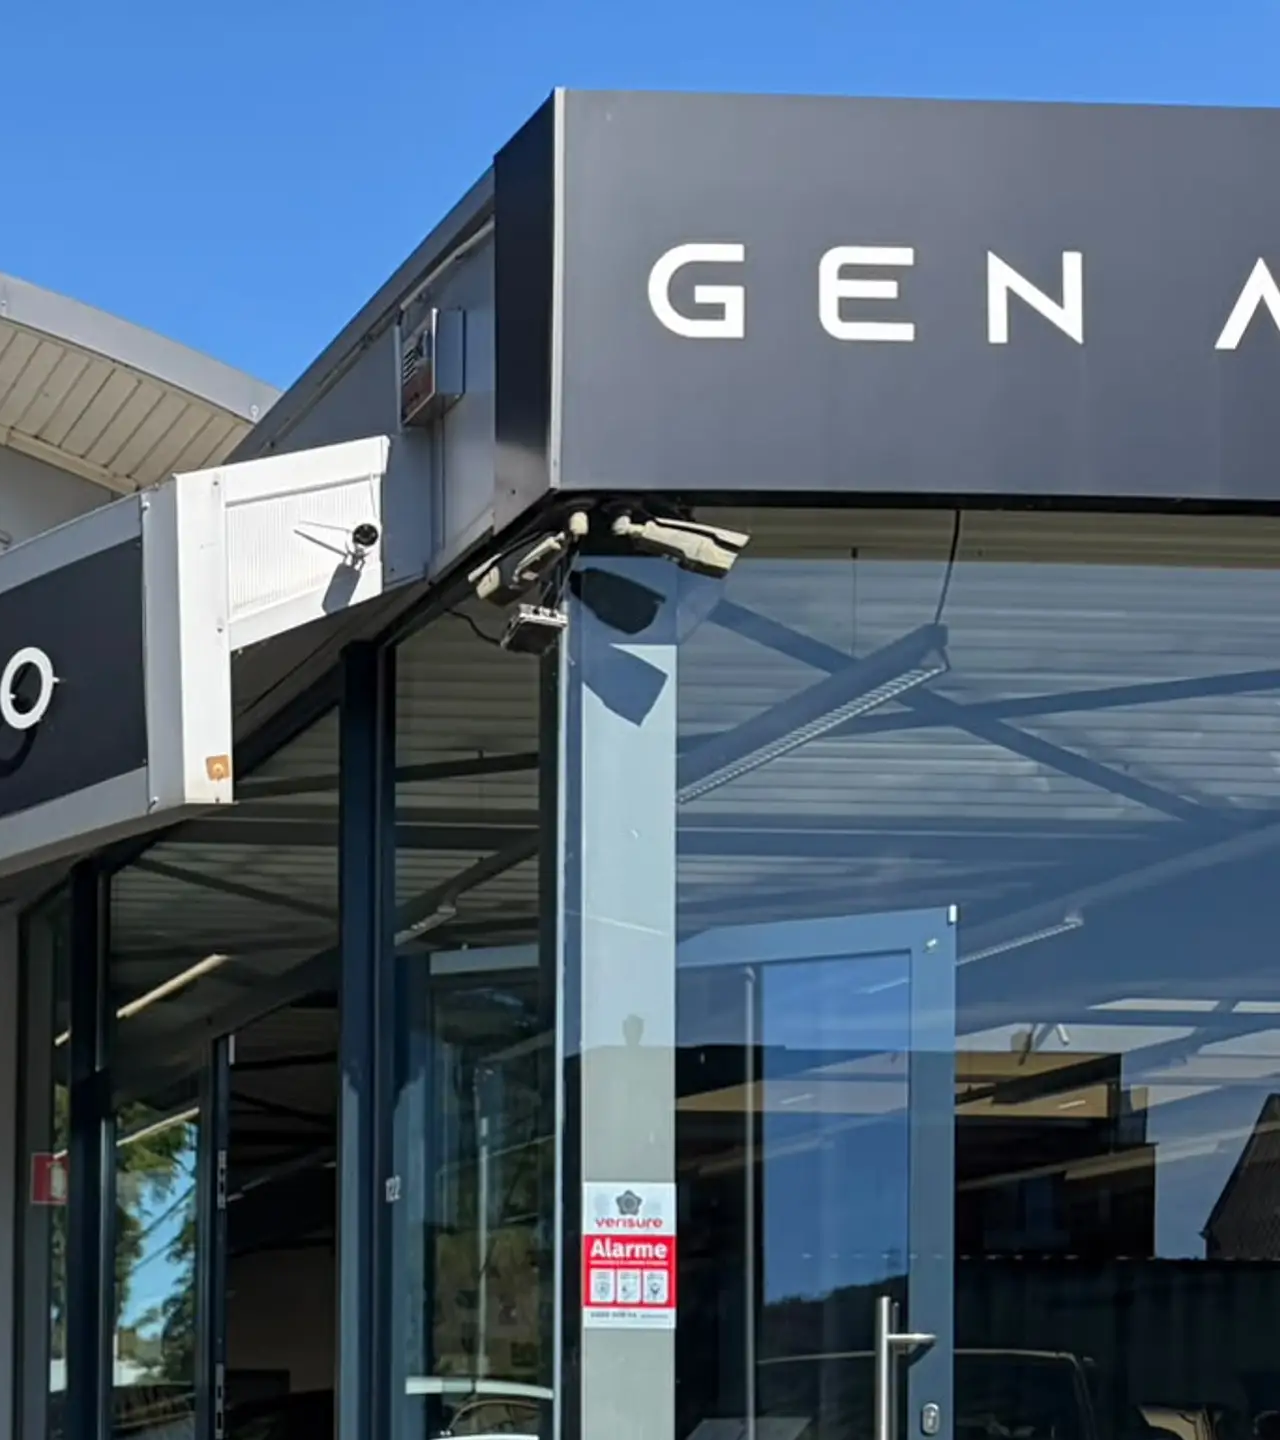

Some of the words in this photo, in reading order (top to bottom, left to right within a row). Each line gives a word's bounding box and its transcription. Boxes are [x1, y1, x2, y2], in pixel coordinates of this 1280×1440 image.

[648, 243, 1084, 344] GEN
[595, 1216, 663, 1229] verisure
[590, 1237, 668, 1259] Alarme
